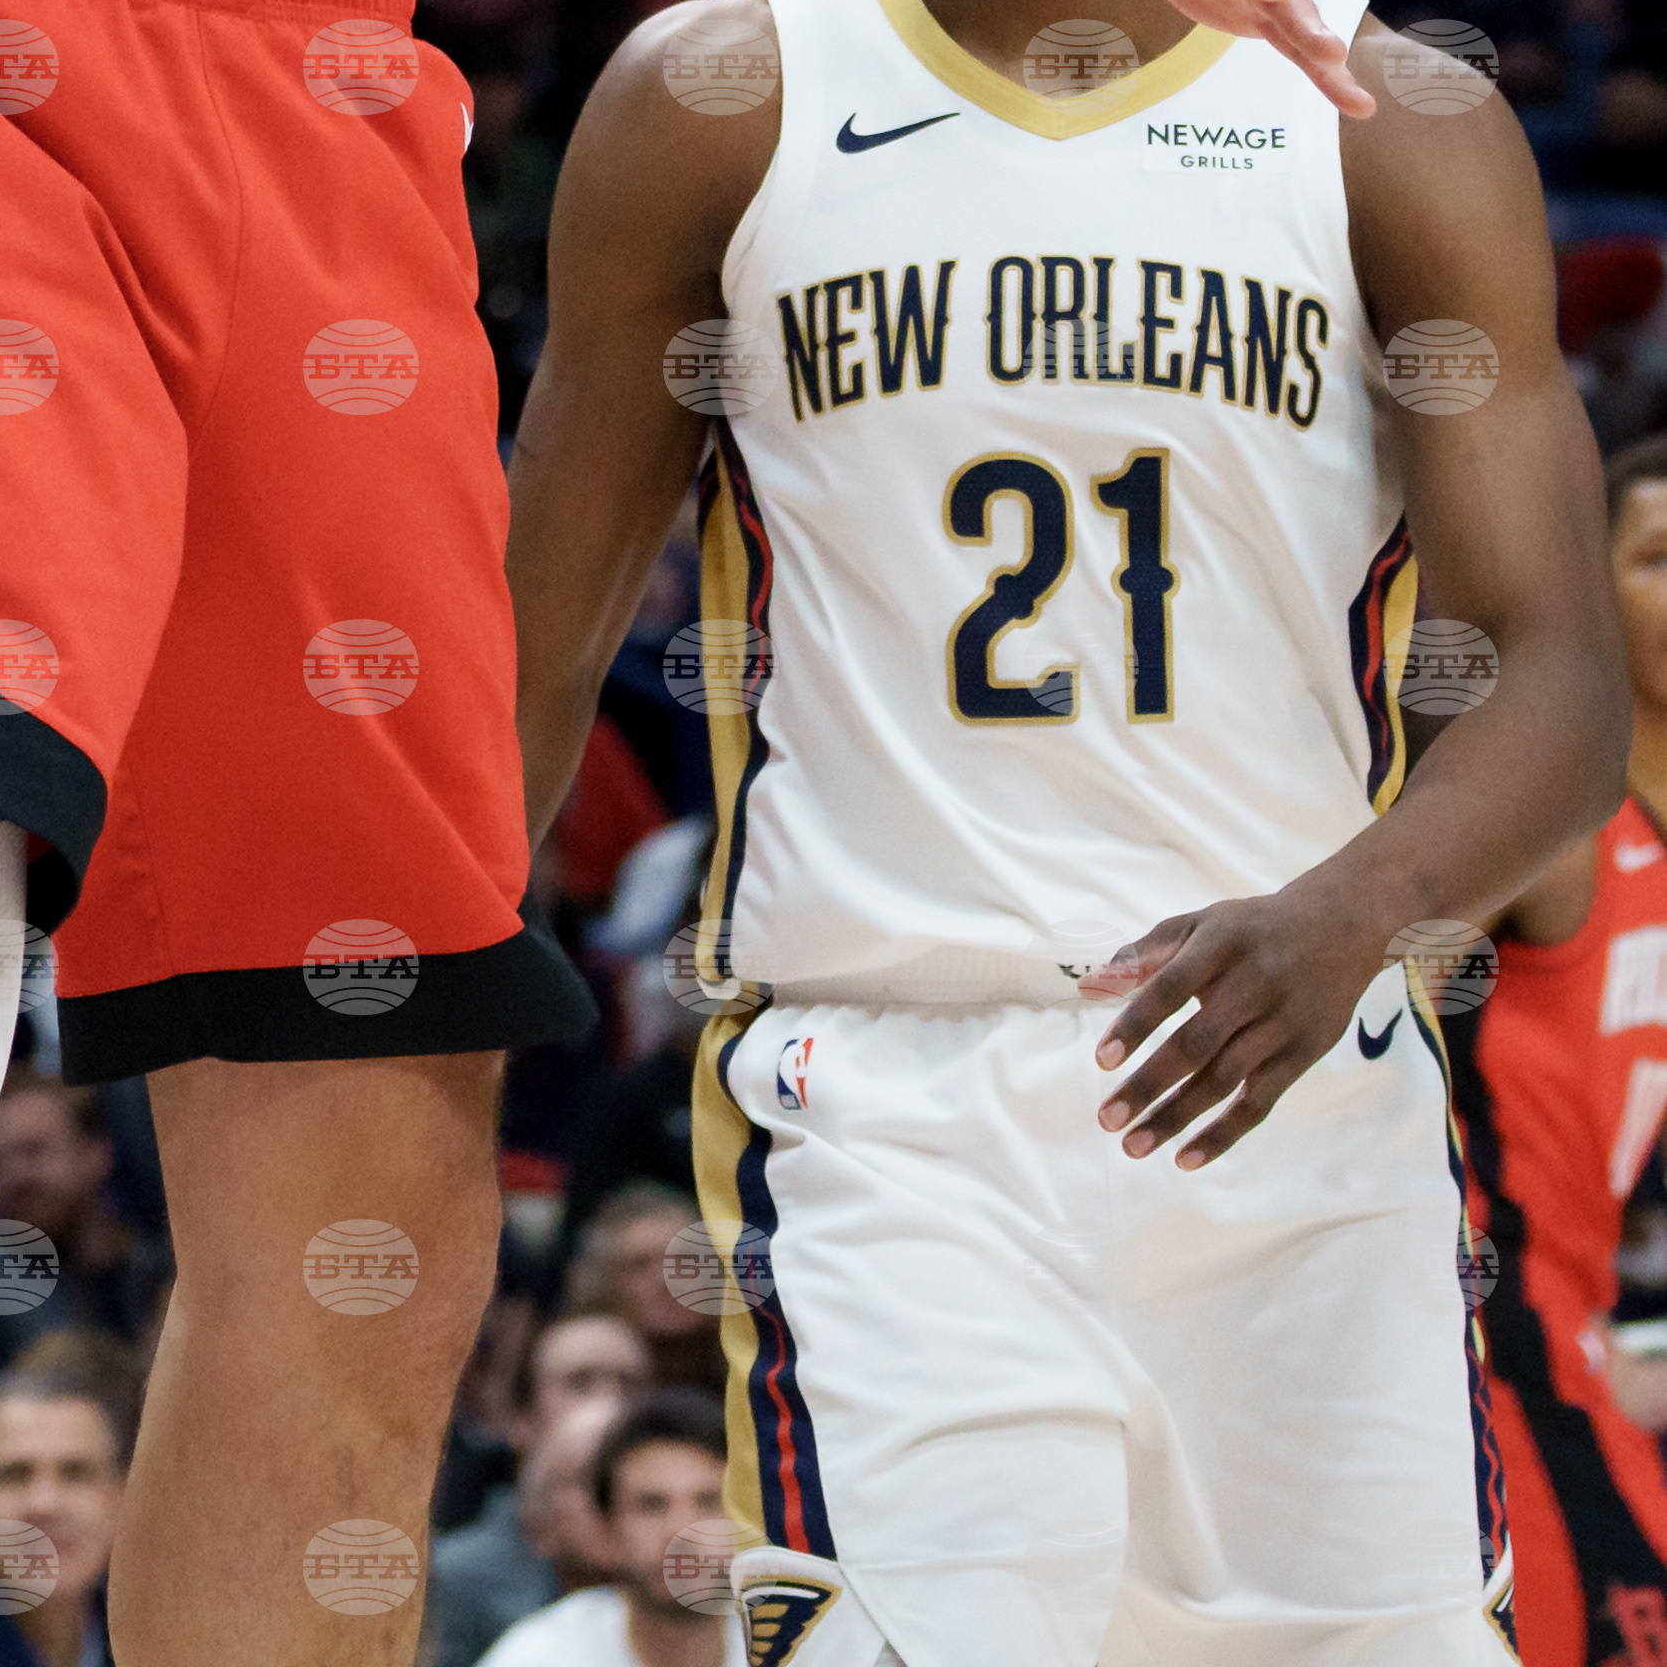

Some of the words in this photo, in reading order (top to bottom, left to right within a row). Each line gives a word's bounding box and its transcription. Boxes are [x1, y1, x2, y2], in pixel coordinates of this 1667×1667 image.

[1147, 123, 1286, 149] NEWAGE
[1180, 154, 1254, 170] GRILLS
[777, 257, 959, 424] NEW
[984, 254, 1332, 431] ORLEANS
[942, 447, 1177, 726] 21
